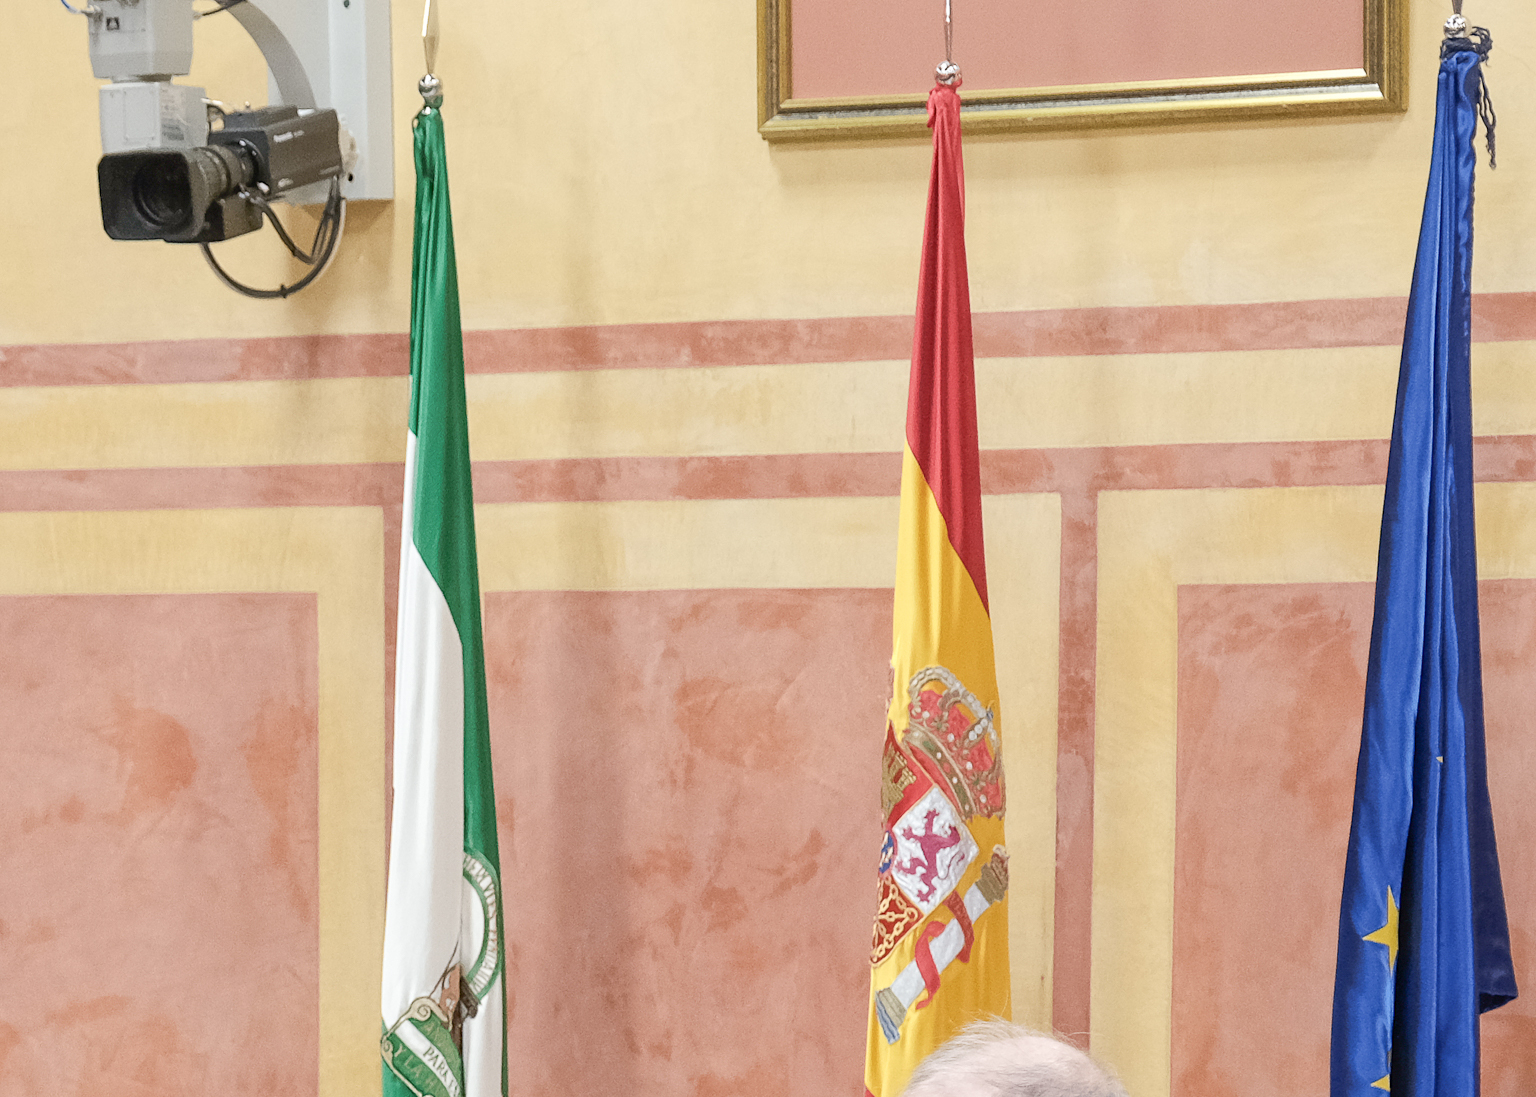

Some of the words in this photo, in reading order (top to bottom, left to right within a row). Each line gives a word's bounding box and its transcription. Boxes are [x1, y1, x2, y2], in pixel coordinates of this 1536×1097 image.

[395, 1043, 406, 1058] Y
[405, 1055, 424, 1079] LA
[423, 1046, 448, 1082] PARA
